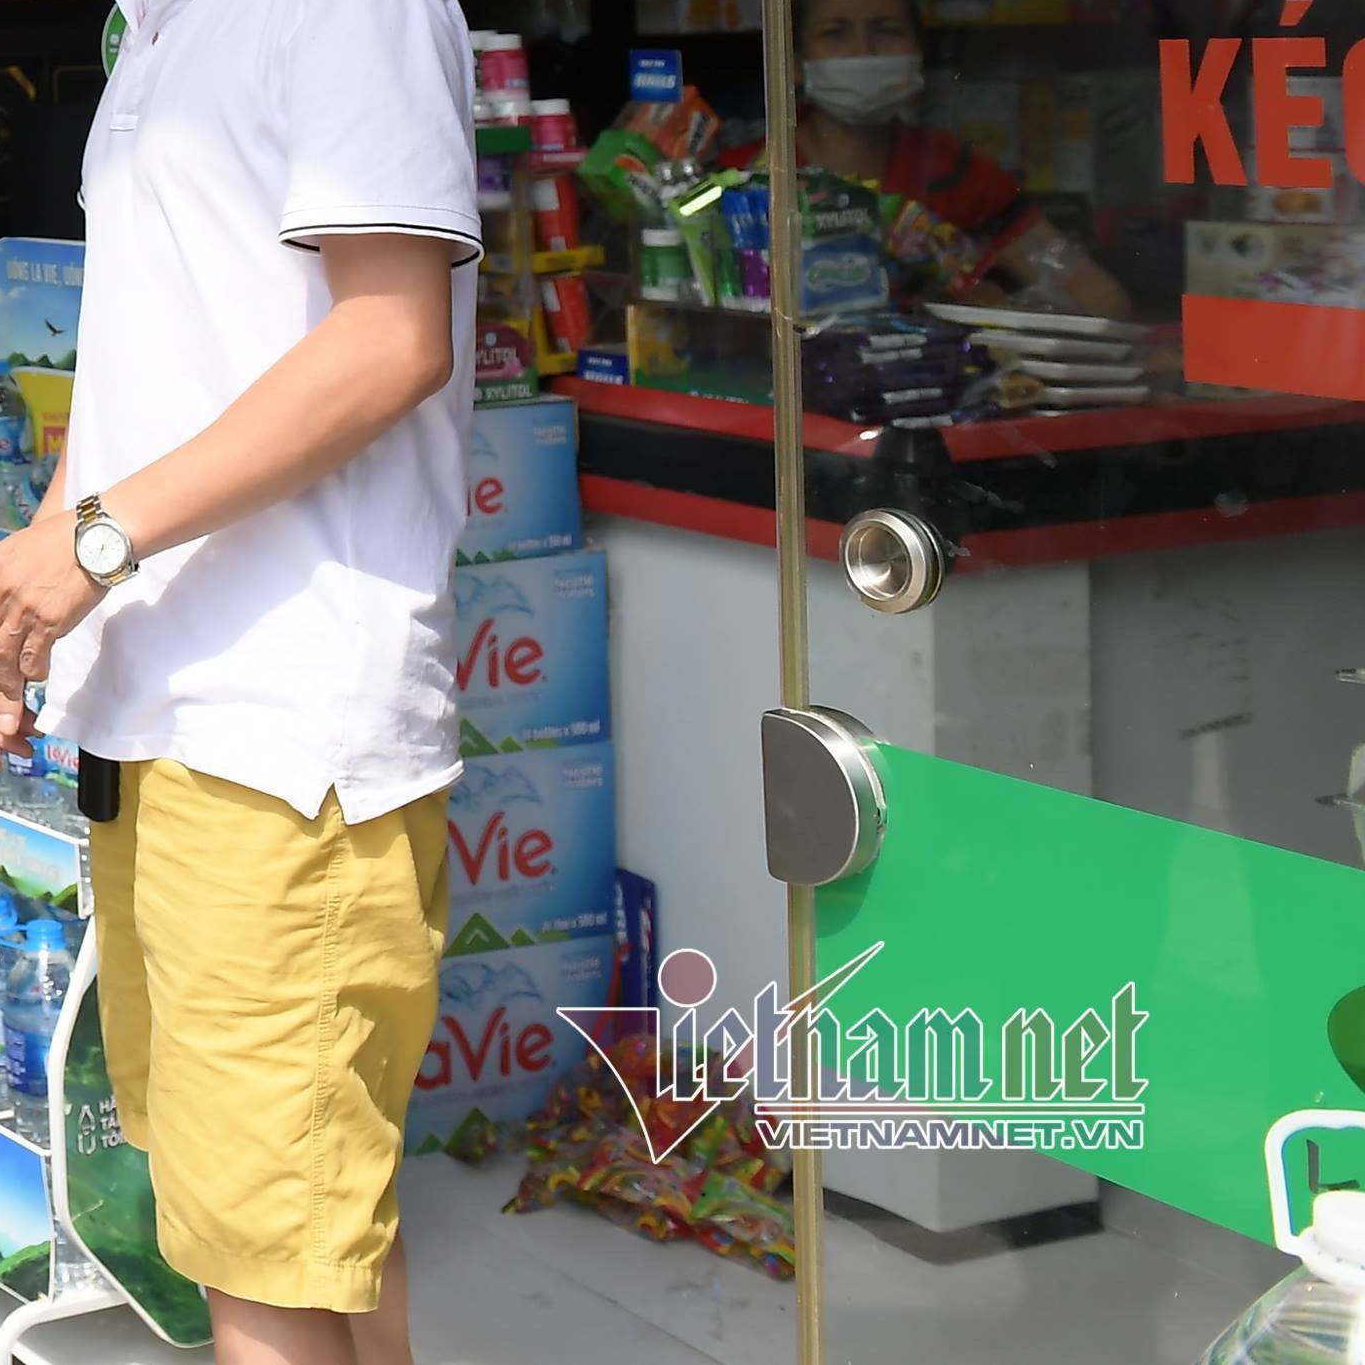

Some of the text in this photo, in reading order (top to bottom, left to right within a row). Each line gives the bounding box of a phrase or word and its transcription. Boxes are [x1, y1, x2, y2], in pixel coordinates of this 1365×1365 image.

[475, 346, 518, 366] YLITOL
[457, 617, 544, 693] Vie
[447, 810, 554, 886] Vie
[414, 1006, 555, 1091] aVie
